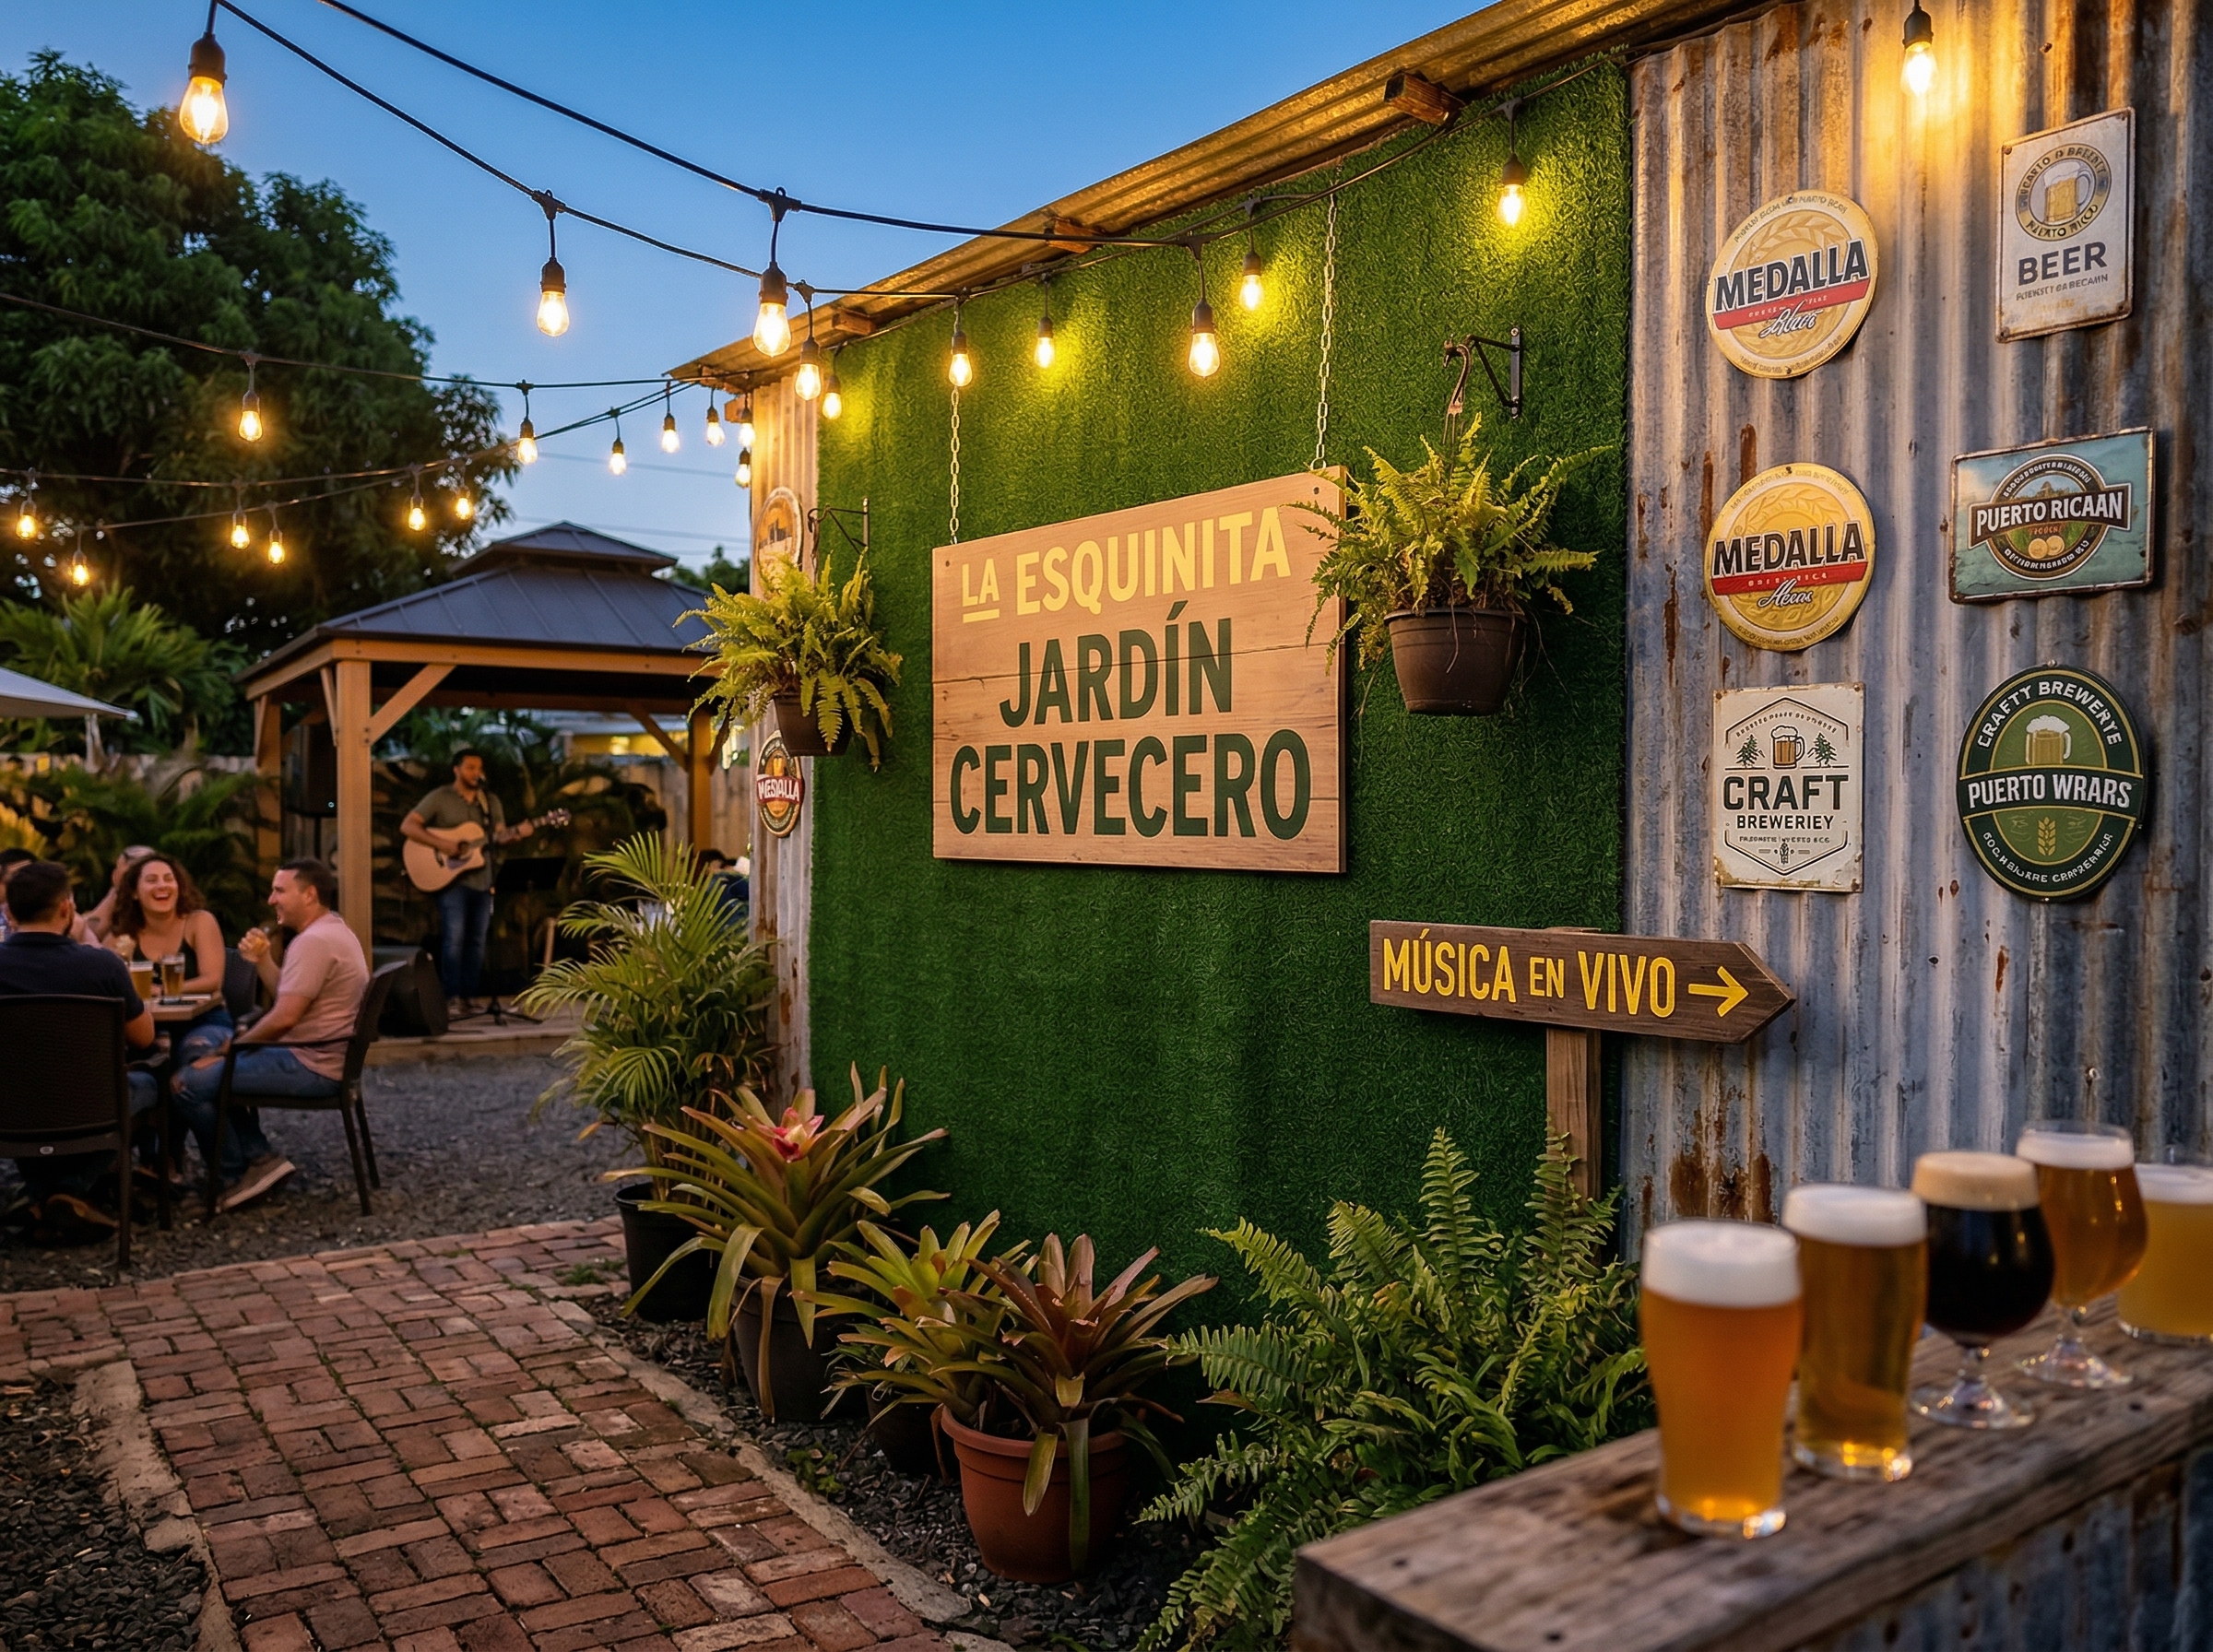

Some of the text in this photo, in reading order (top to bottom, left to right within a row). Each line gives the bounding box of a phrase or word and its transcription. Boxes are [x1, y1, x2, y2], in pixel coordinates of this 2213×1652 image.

[1715, 239, 1869, 313] MEDALLA
[2018, 241, 2108, 287] BEER
[1976, 490, 2124, 537] PUERTO RICAAN
[962, 506, 1292, 616] LA ESQUINITA
[1712, 521, 1866, 578] MEDALLA
[999, 599, 1232, 728] JARDÍN
[1977, 680, 2123, 749] CRAFTY BREWERYE
[950, 728, 1311, 841] CERVECERO
[1722, 774, 1849, 811] CRAFT
[1968, 773, 2132, 808] PUERTO WRARS
[1735, 814, 1834, 830] BREWERIEY
[1382, 927, 1676, 1019] MÚSICA EN VIVO
